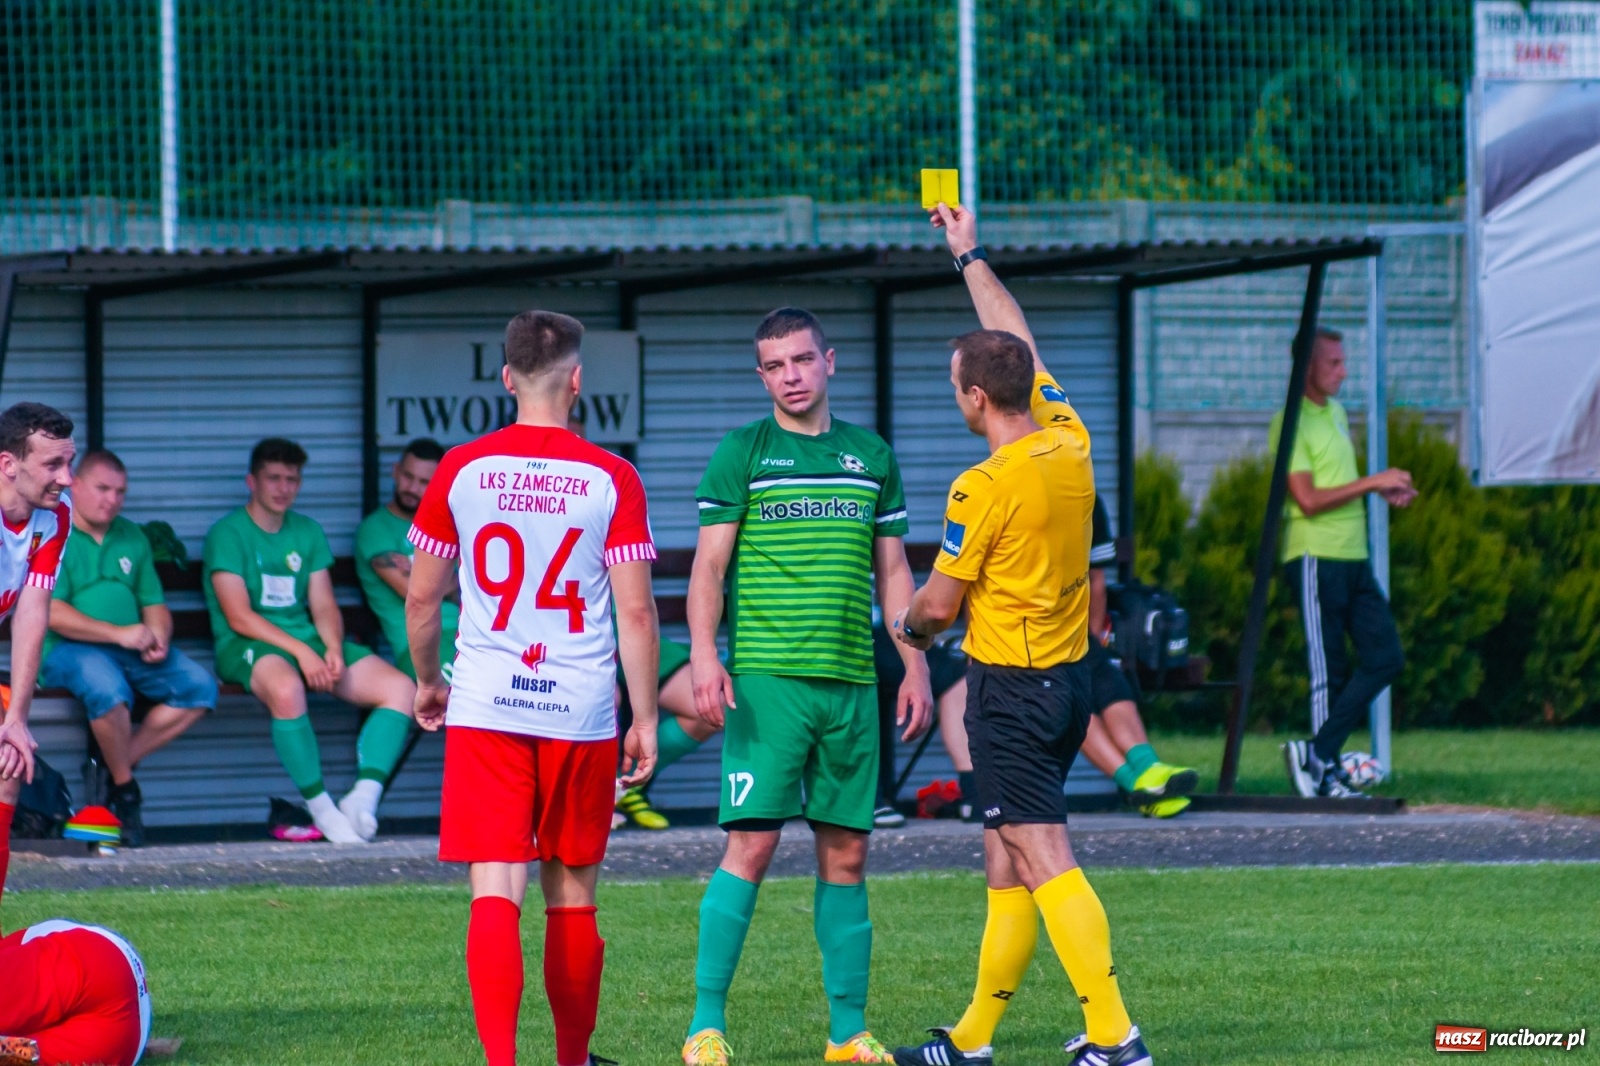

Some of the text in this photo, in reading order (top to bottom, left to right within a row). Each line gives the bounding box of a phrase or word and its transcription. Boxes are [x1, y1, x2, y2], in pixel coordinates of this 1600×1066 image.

[526, 461, 548, 470] 1981
[479, 472, 590, 497] LKS ZAMECZEK
[497, 493, 567, 516] CZERNICA
[472, 521, 588, 634] 94
[511, 674, 557, 693] Husar
[493, 696, 570, 714] GALERIA CIEPŁA
[728, 772, 754, 807] 17
